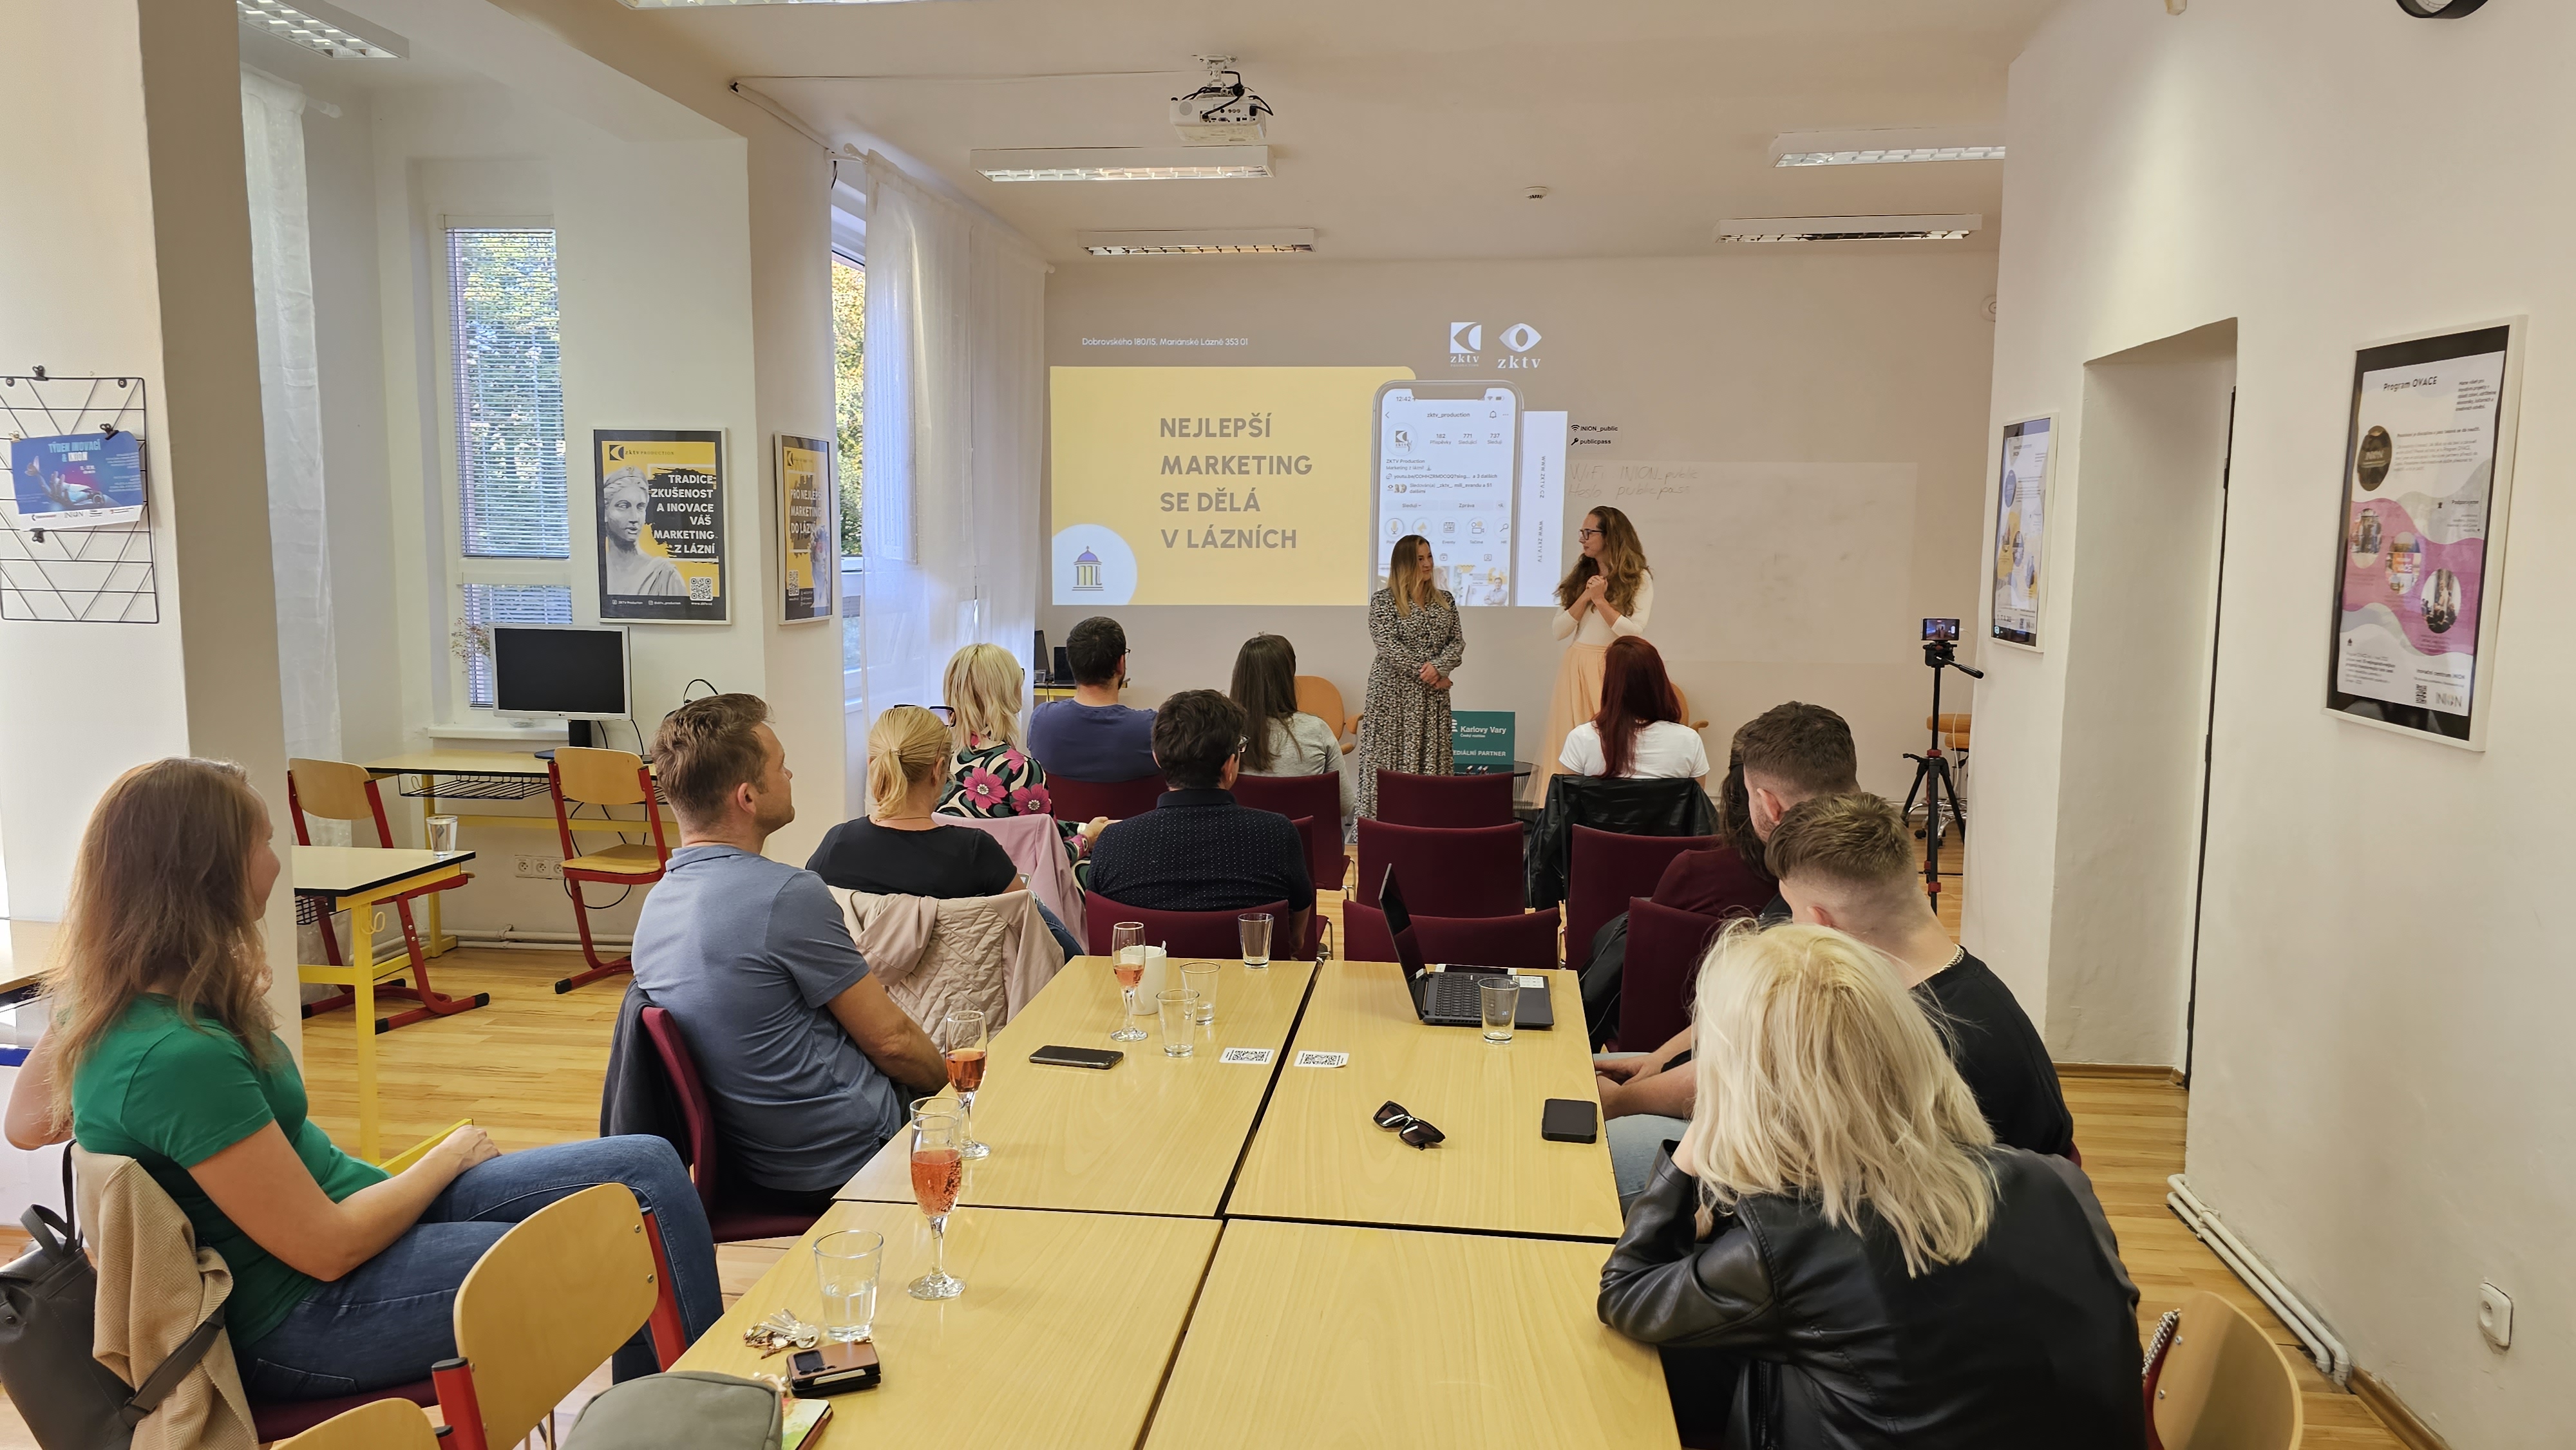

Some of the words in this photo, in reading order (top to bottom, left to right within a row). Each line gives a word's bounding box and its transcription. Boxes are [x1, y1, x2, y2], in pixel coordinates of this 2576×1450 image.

[1082, 337, 1132, 346] Dobrovského
[1160, 337, 1199, 346] Mariánské
[1200, 337, 1224, 346] Lázně
[1225, 337, 1239, 346] 353
[1240, 337, 1248, 346] 01
[1450, 354, 1479, 363] zktv
[1497, 355, 1541, 368] zktv
[2383, 382, 2410, 392] Program
[2412, 376, 2438, 387] OVACE
[1160, 412, 1272, 438] NEJLEPŠÍ
[1160, 455, 1312, 475] MARKETING
[668, 475, 714, 484] TRADICE
[650, 487, 713, 498] ZKUŠENOST
[790, 489, 800, 500] PRO
[1160, 492, 1189, 512] SE
[1197, 487, 1260, 512] DĚLÁ
[657, 503, 665, 511] A
[667, 504, 714, 513] INOVACE
[790, 505, 822, 517] MARKETING
[690, 514, 712, 525] VÁŠ
[791, 522, 799, 534] DO
[654, 530, 715, 539] MARKETING
[1160, 529, 1179, 549] V
[1188, 524, 1296, 549] LÁZNÍCH
[674, 545, 681, 553] Z
[684, 543, 715, 554] LÁZNÍ
[1460, 726, 1488, 734] Karlovy
[1490, 726, 1506, 735] Vary
